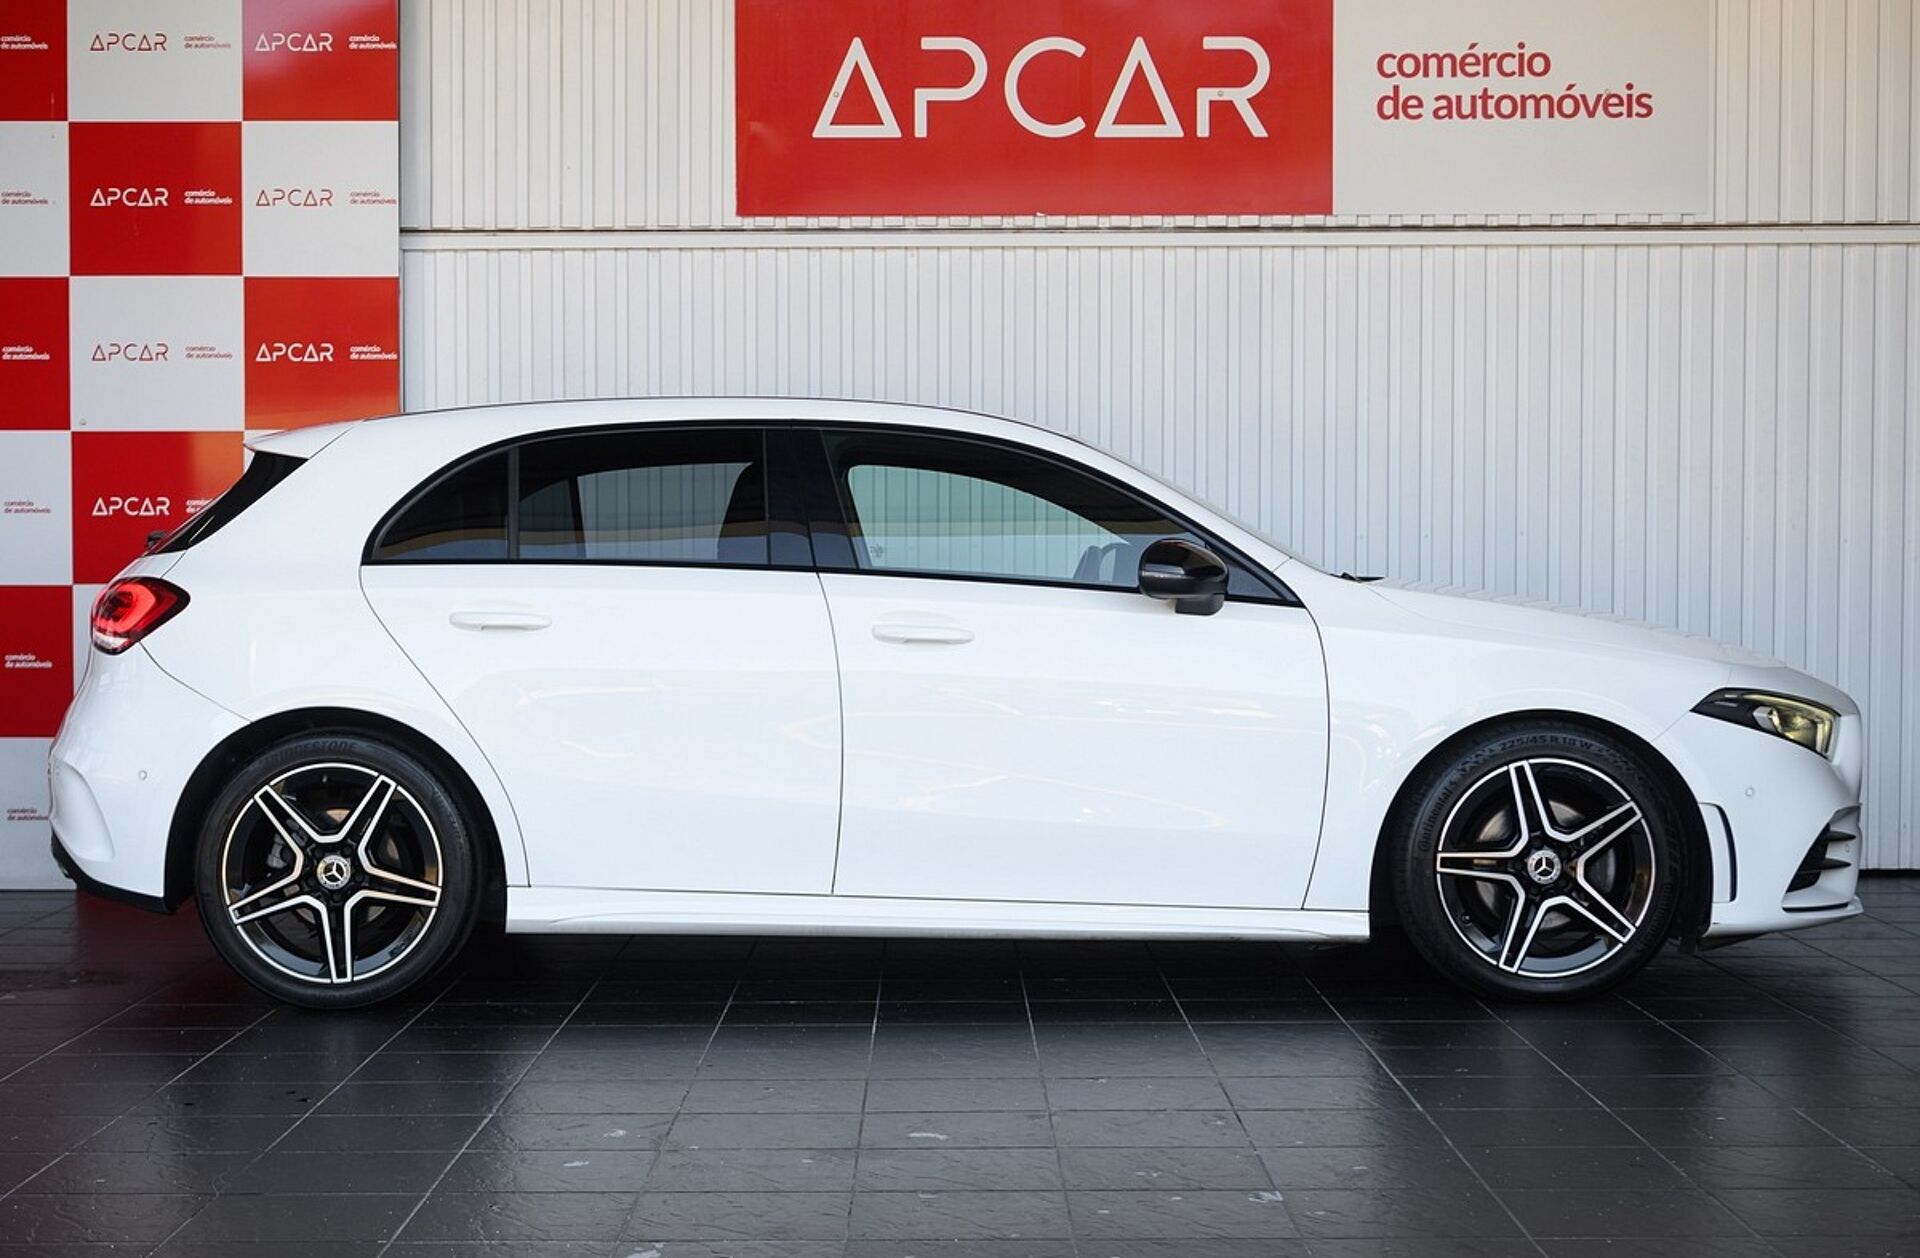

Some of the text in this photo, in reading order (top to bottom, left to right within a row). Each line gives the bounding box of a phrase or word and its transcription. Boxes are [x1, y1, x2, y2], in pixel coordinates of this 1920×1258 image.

[90, 32, 168, 53] APCAR
[255, 32, 333, 53] APCAR
[1376, 42, 1551, 78] comércio
[812, 36, 1271, 138] APCAR
[1376, 82, 1654, 120] de automóveis
[90, 187, 169, 208] APCAR
[255, 188, 333, 208] APCAR
[91, 342, 168, 363] APCAR
[255, 342, 334, 363] APCAR
[91, 496, 171, 518] APCAR
[1500, 735, 1549, 751] 225/45
[1550, 735, 1561, 746] R
